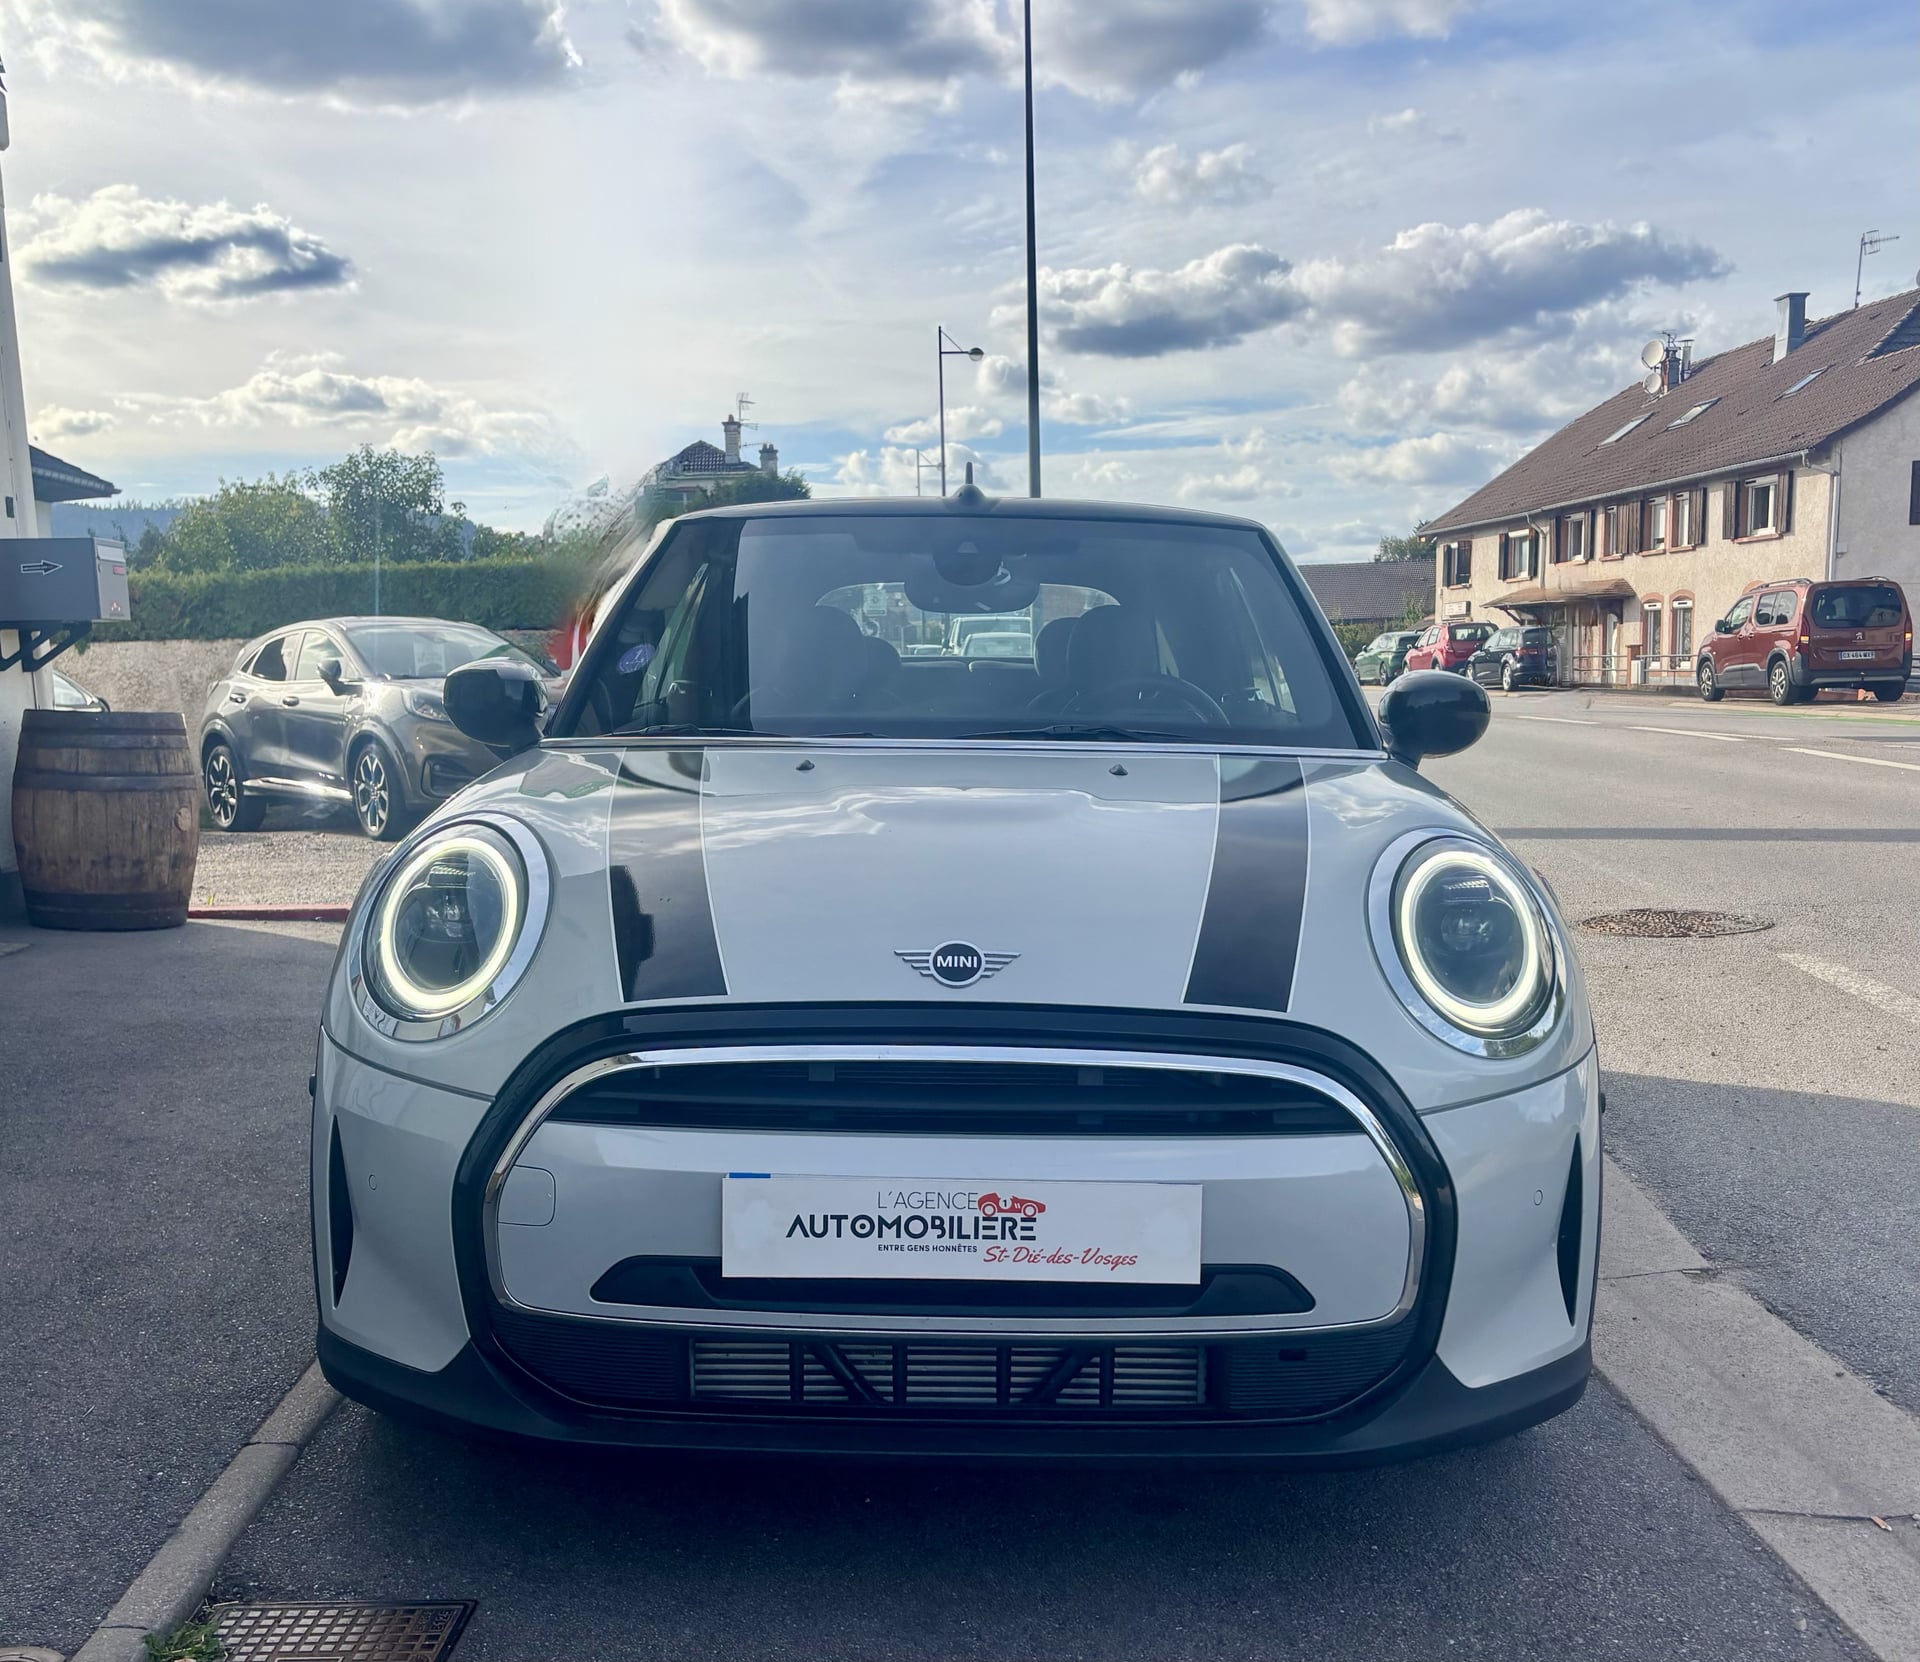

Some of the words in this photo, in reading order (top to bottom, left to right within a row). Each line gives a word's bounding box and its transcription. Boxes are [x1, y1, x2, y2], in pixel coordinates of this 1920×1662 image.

[936, 955, 978, 968] MINI
[877, 1243, 905, 1252] ENTRE
[906, 1244, 930, 1252] GENS
[932, 1243, 978, 1253] HONNÊTES
